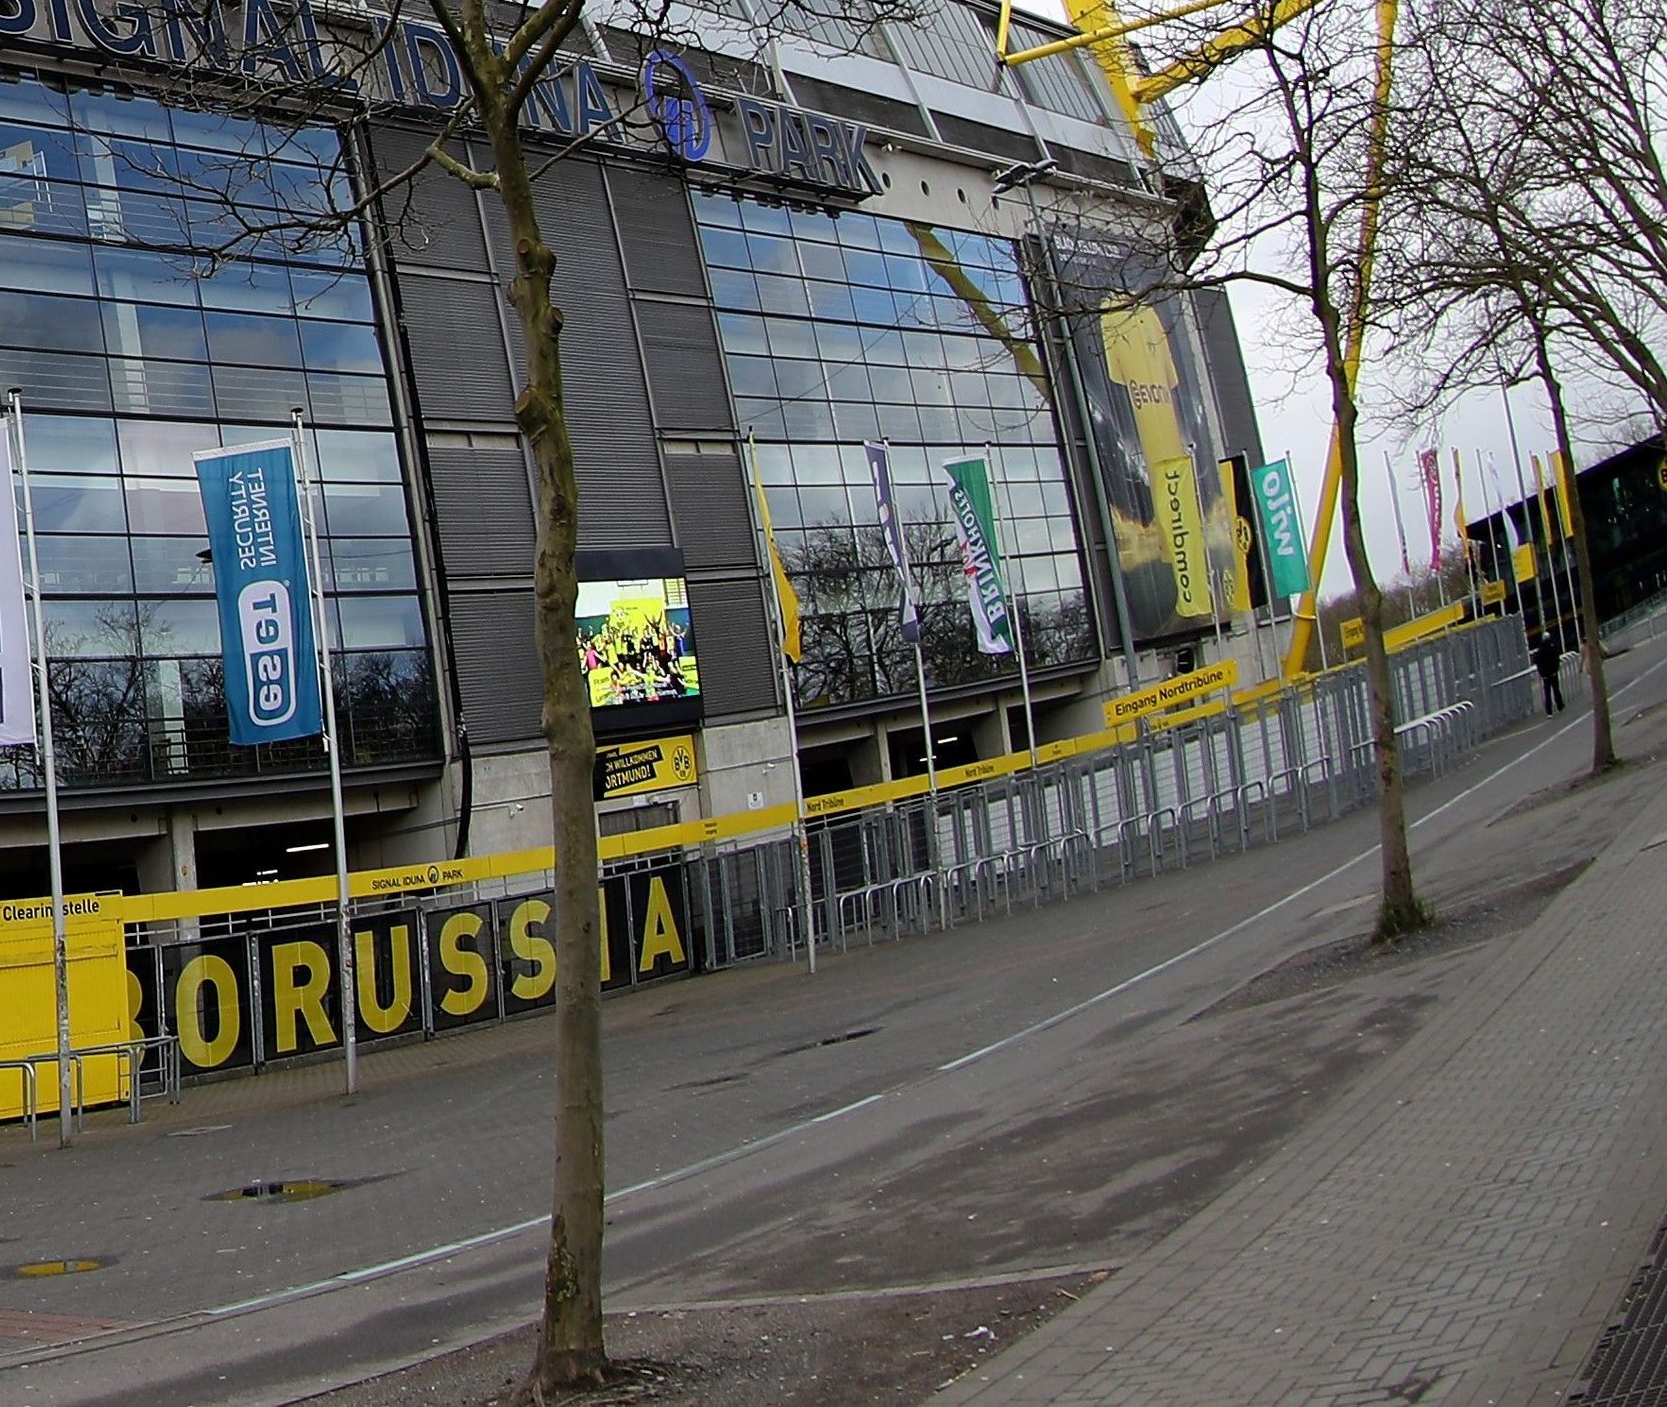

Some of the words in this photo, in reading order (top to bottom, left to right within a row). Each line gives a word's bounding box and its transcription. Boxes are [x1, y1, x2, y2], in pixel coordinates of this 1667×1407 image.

[375, 16, 624, 144] IDNA
[734, 97, 883, 195] PARK
[1115, 693, 1157, 716] Eingang
[1159, 670, 1224, 701] Nordtribüne
[807, 800, 821, 813] Nord
[371, 877, 402, 891] SIGNAL
[442, 868, 464, 881] PARK
[2, 898, 100, 922] Clearinstelle
